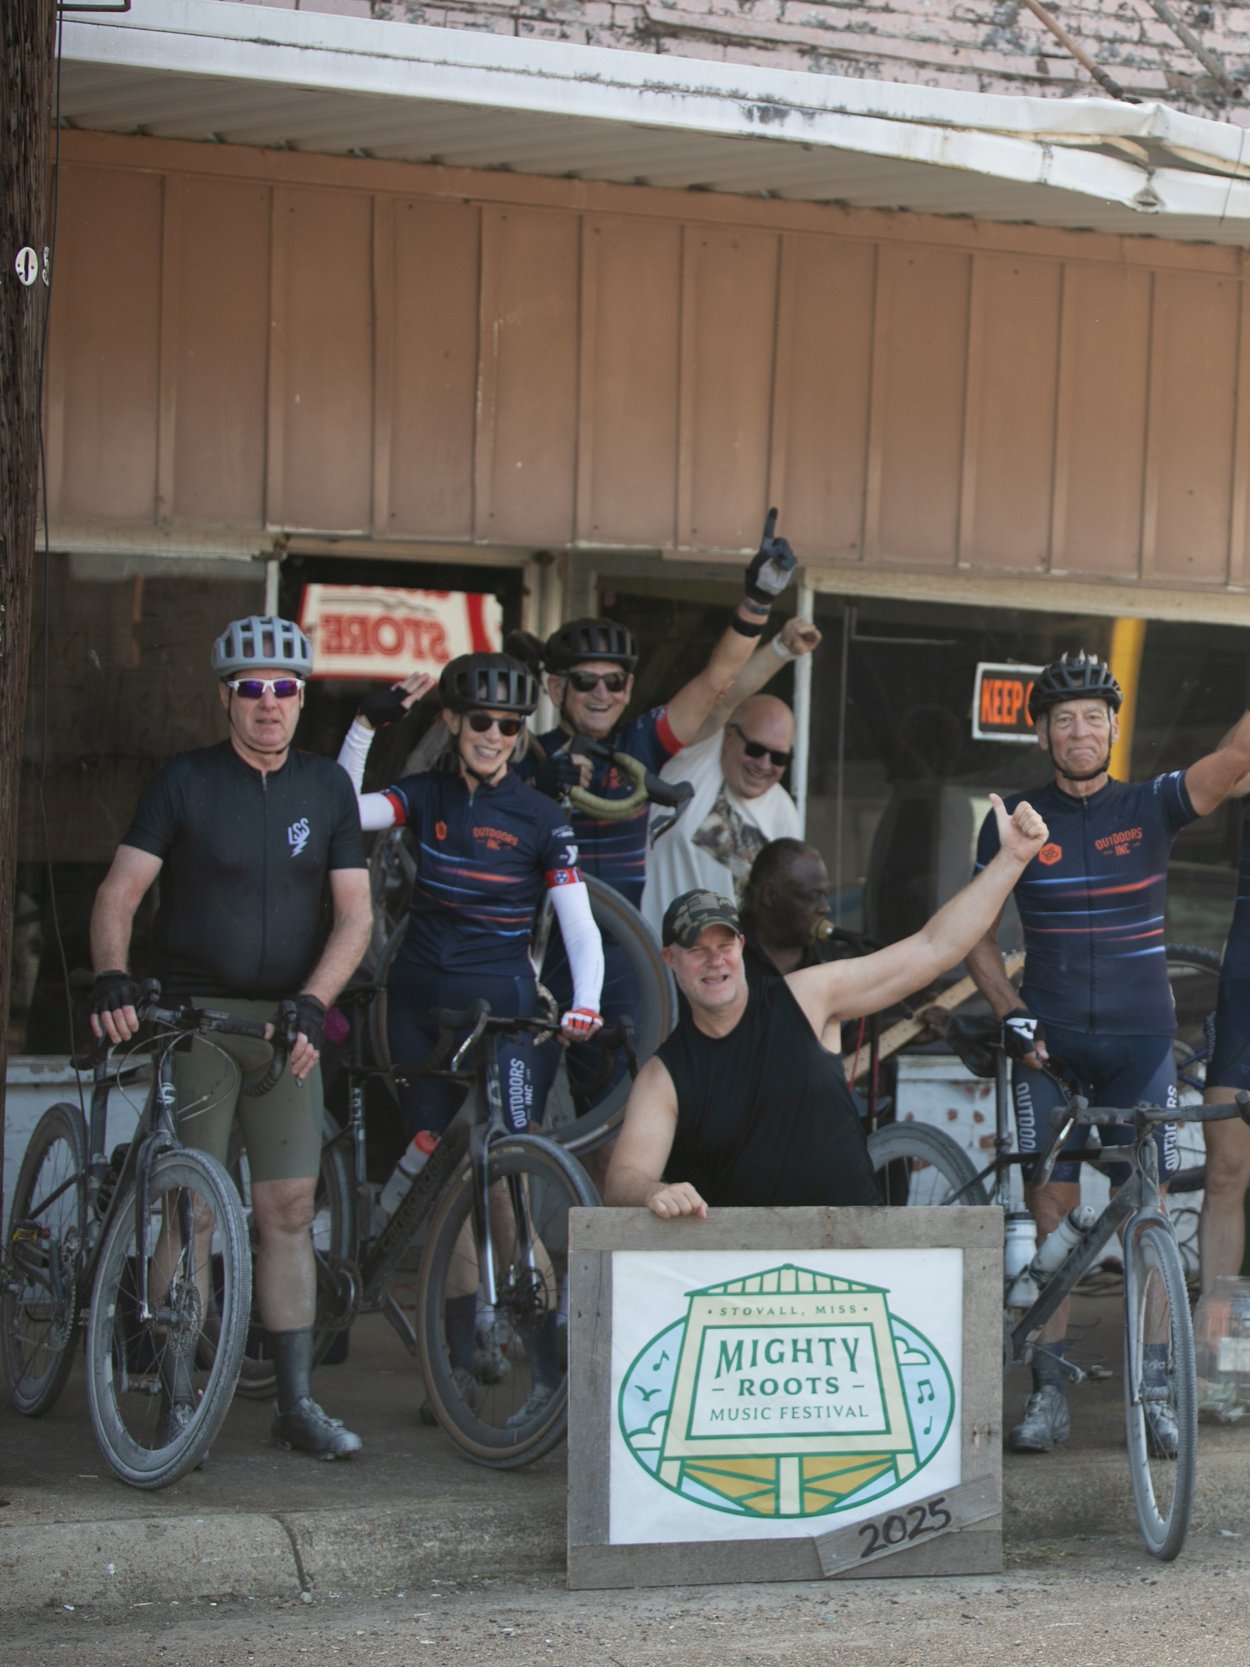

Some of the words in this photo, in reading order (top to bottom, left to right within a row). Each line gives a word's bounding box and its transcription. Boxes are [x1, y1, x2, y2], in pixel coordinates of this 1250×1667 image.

[980, 678, 1024, 726] KEEP
[473, 826, 518, 848] OUTDOORS
[1095, 827, 1143, 850] OUTDOORS
[1115, 844, 1130, 856] INC
[509, 1058, 527, 1129] OUTDOORS
[524, 1085, 533, 1105] INC
[719, 1304, 806, 1318] STOVALL,
[815, 1304, 858, 1315] MISS
[714, 1337, 860, 1379] MIGHTY
[737, 1376, 841, 1397] ROOTS
[709, 1406, 772, 1422] MUSIC
[779, 1404, 869, 1421] FESTIVAL
[858, 1496, 952, 1559] 2025
